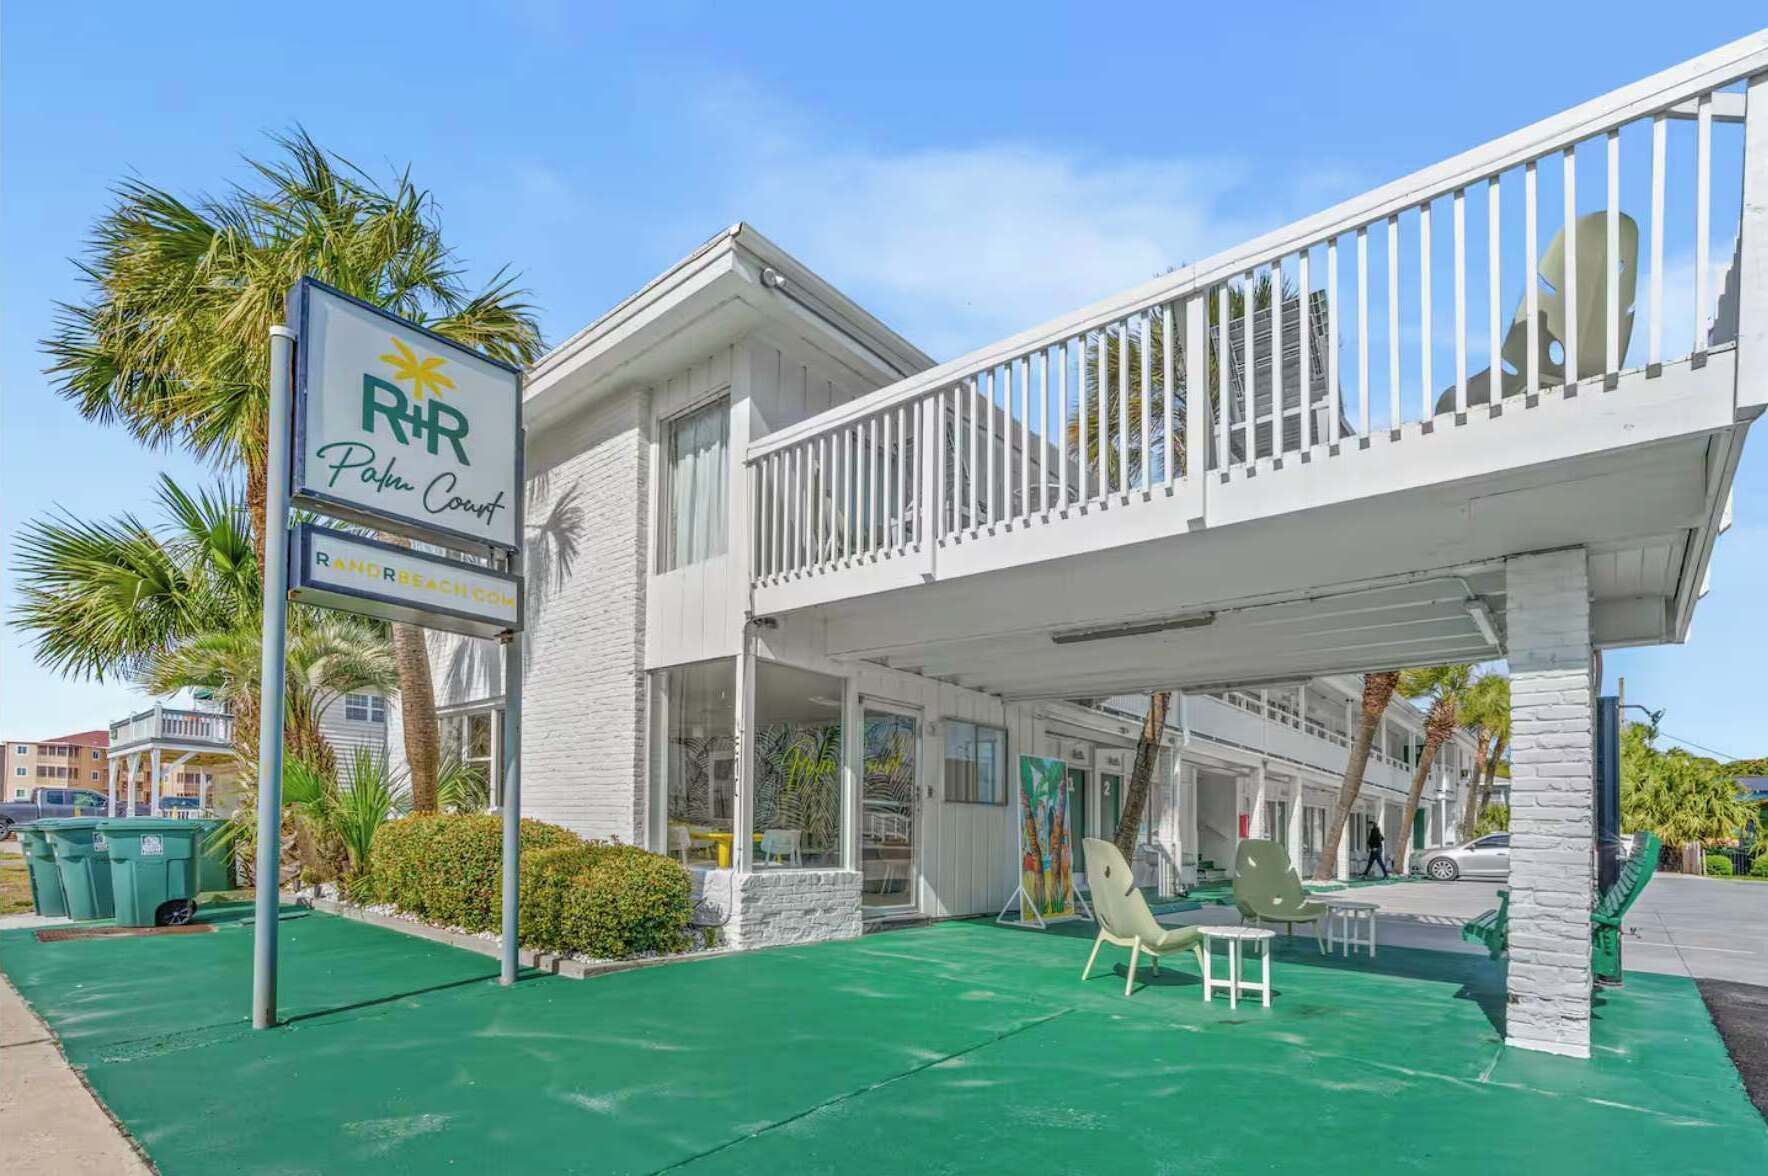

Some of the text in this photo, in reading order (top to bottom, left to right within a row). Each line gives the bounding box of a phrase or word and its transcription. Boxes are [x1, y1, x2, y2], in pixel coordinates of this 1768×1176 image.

[362, 373, 471, 466] R+R
[316, 441, 505, 526] Palm Court
[316, 552, 516, 607] RANDRBEACHCOM
[1103, 780, 1111, 797] 2
